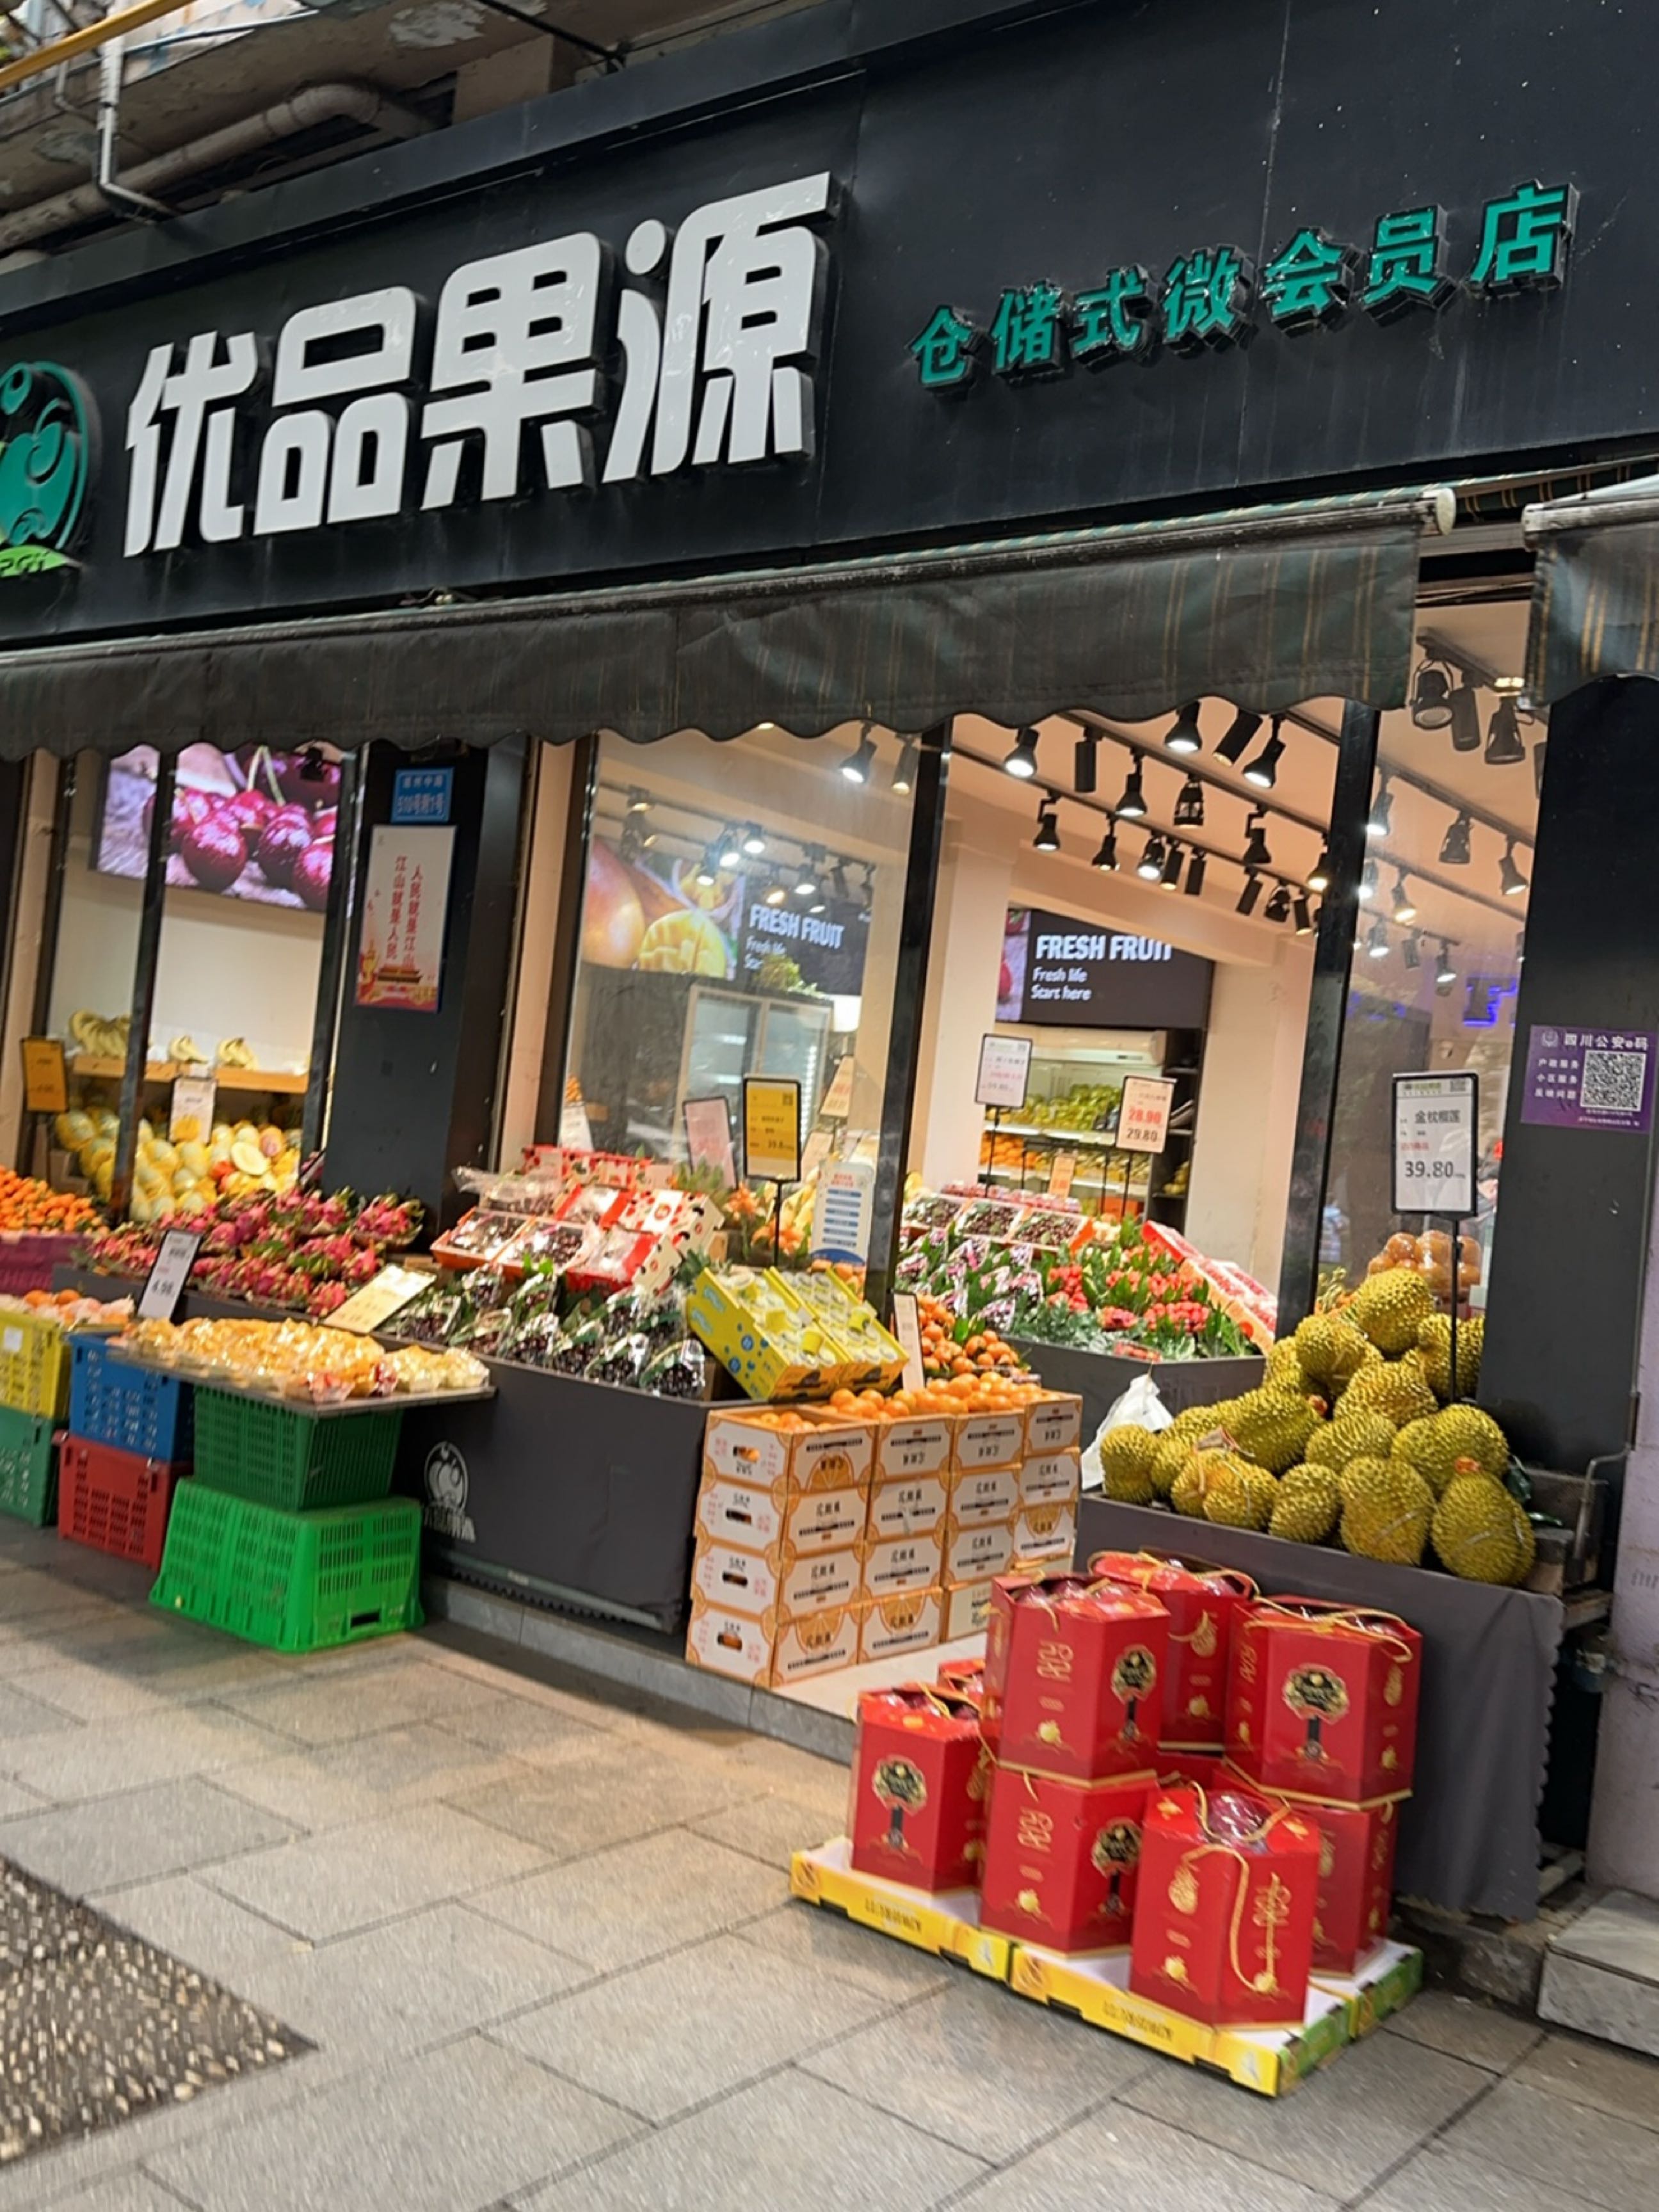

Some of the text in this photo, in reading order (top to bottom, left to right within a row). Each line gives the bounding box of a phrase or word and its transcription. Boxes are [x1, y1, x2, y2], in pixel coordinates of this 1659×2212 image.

[911, 181, 1571, 387] 仓储式微会员店
[124, 172, 831, 557] 优品果源
[749, 903, 845, 949] FRESH FRUIT
[1035, 934, 1107, 959] FRESH
[1032, 966, 1087, 982] Fresh life
[1030, 984, 1092, 1000] Start here
[1564, 1032, 1647, 1050] 四川公安e码
[1404, 1160, 1454, 1179] 39.80
